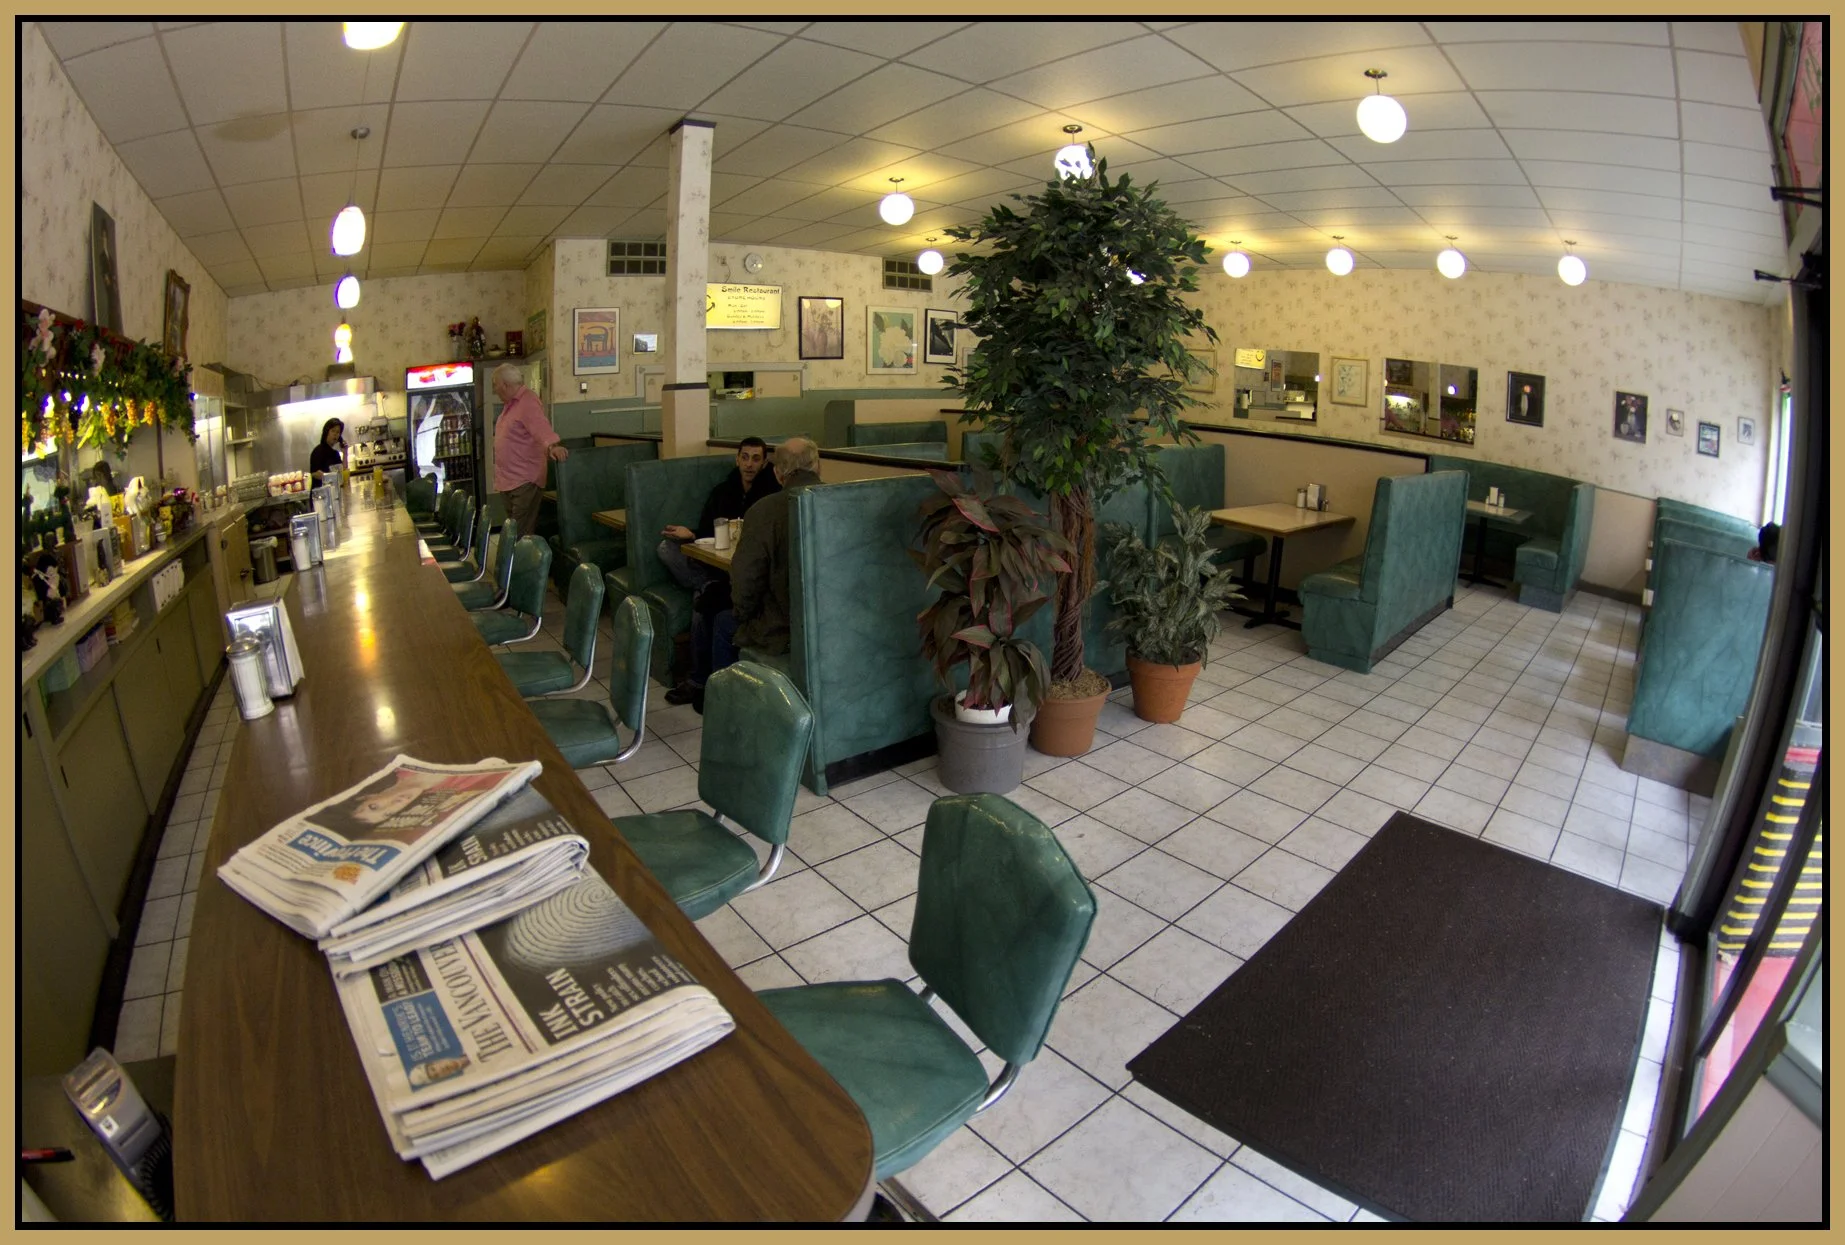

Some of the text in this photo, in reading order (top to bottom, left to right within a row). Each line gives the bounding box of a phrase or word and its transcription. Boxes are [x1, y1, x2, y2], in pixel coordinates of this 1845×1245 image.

[721, 285, 780, 295] Smile Restaurant
[428, 939, 492, 1030] VANCOUVER
[545, 968, 604, 1027] STRAIN
[538, 1002, 579, 1040] INK
[472, 1022, 513, 1063] THE
